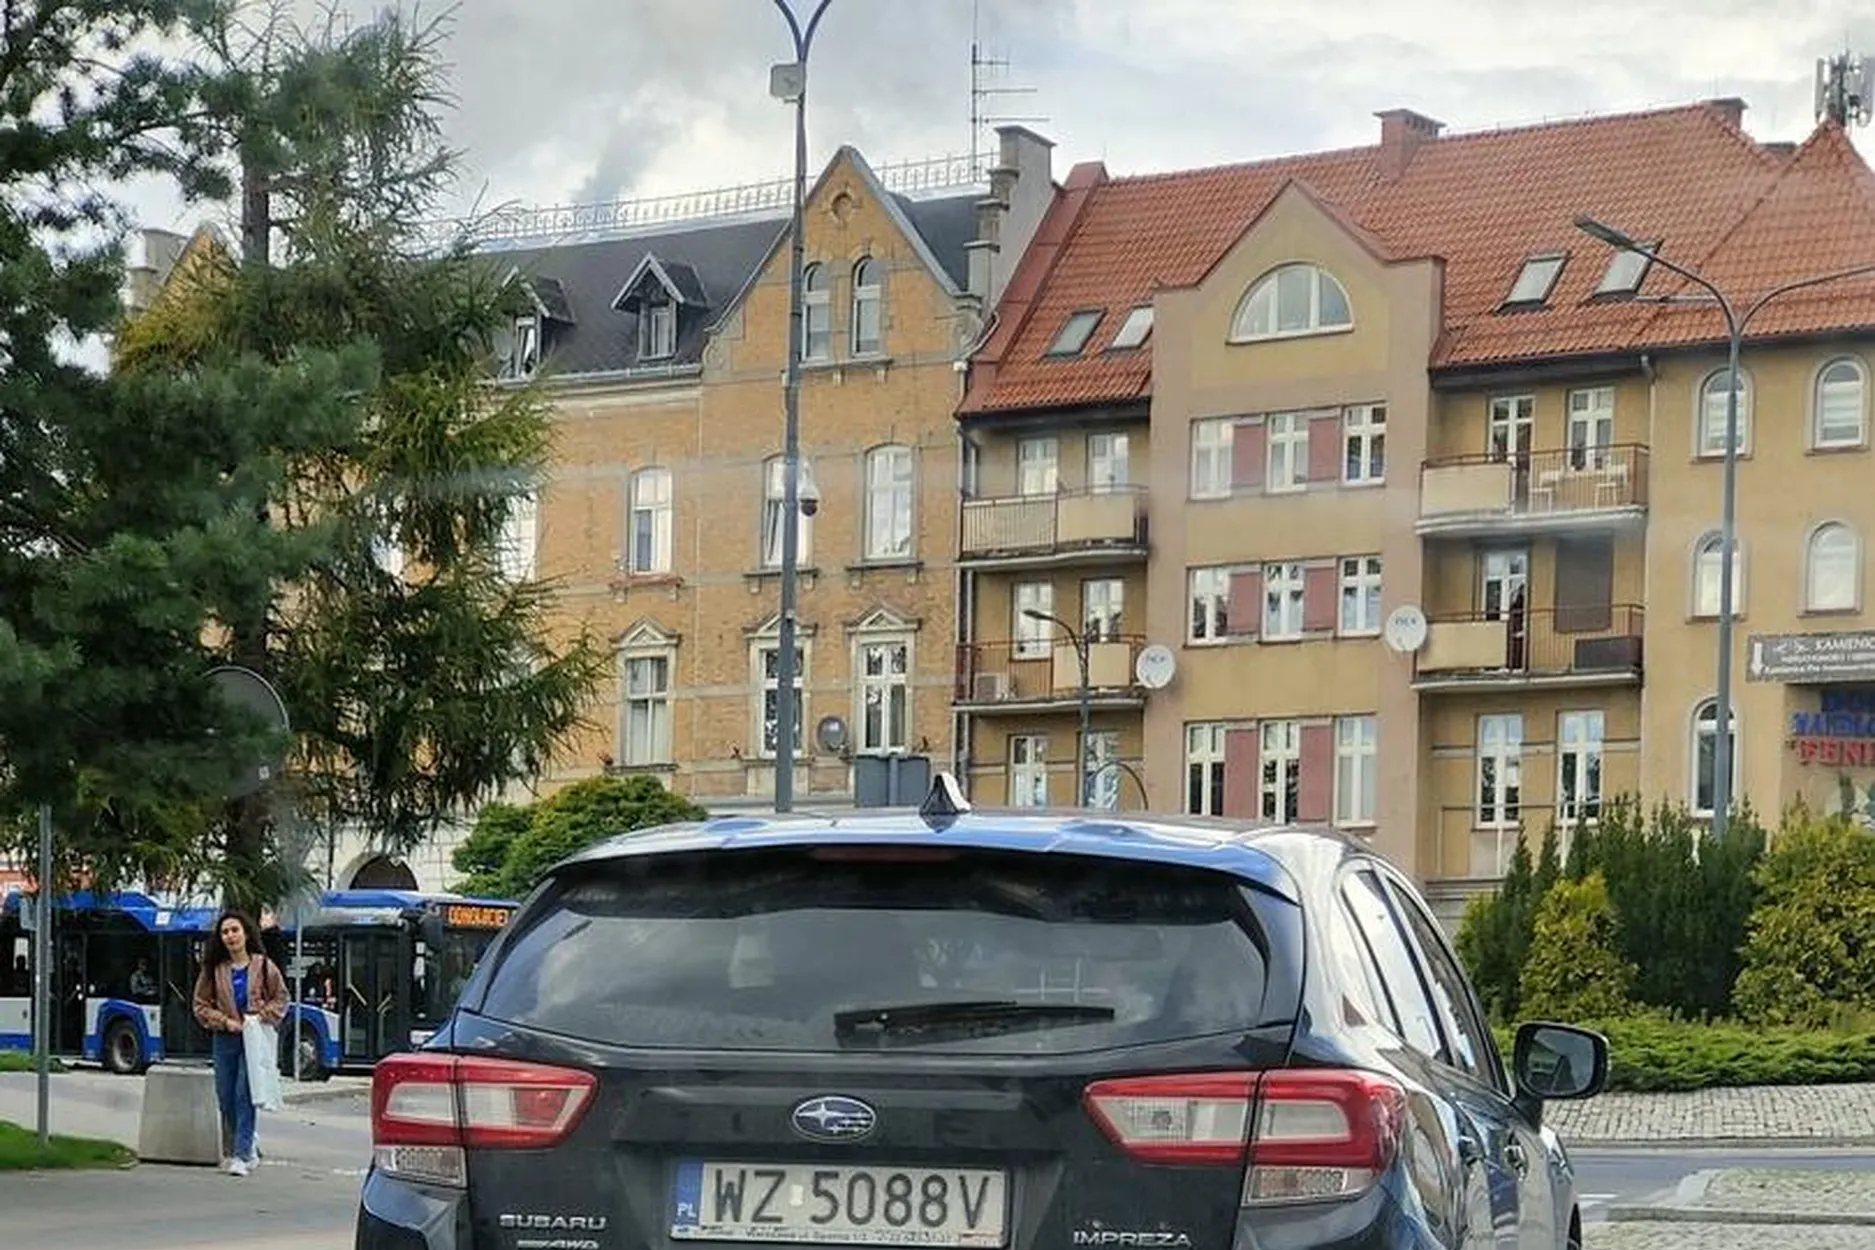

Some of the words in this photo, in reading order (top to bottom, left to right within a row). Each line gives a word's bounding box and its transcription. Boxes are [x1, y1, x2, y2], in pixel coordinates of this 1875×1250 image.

[714, 1168, 787, 1223] WZ
[810, 1170, 989, 1229] 5088V
[676, 1204, 697, 1217] PL
[499, 1214, 608, 1230] SUBARU
[1073, 1231, 1193, 1247] IMPREZA
